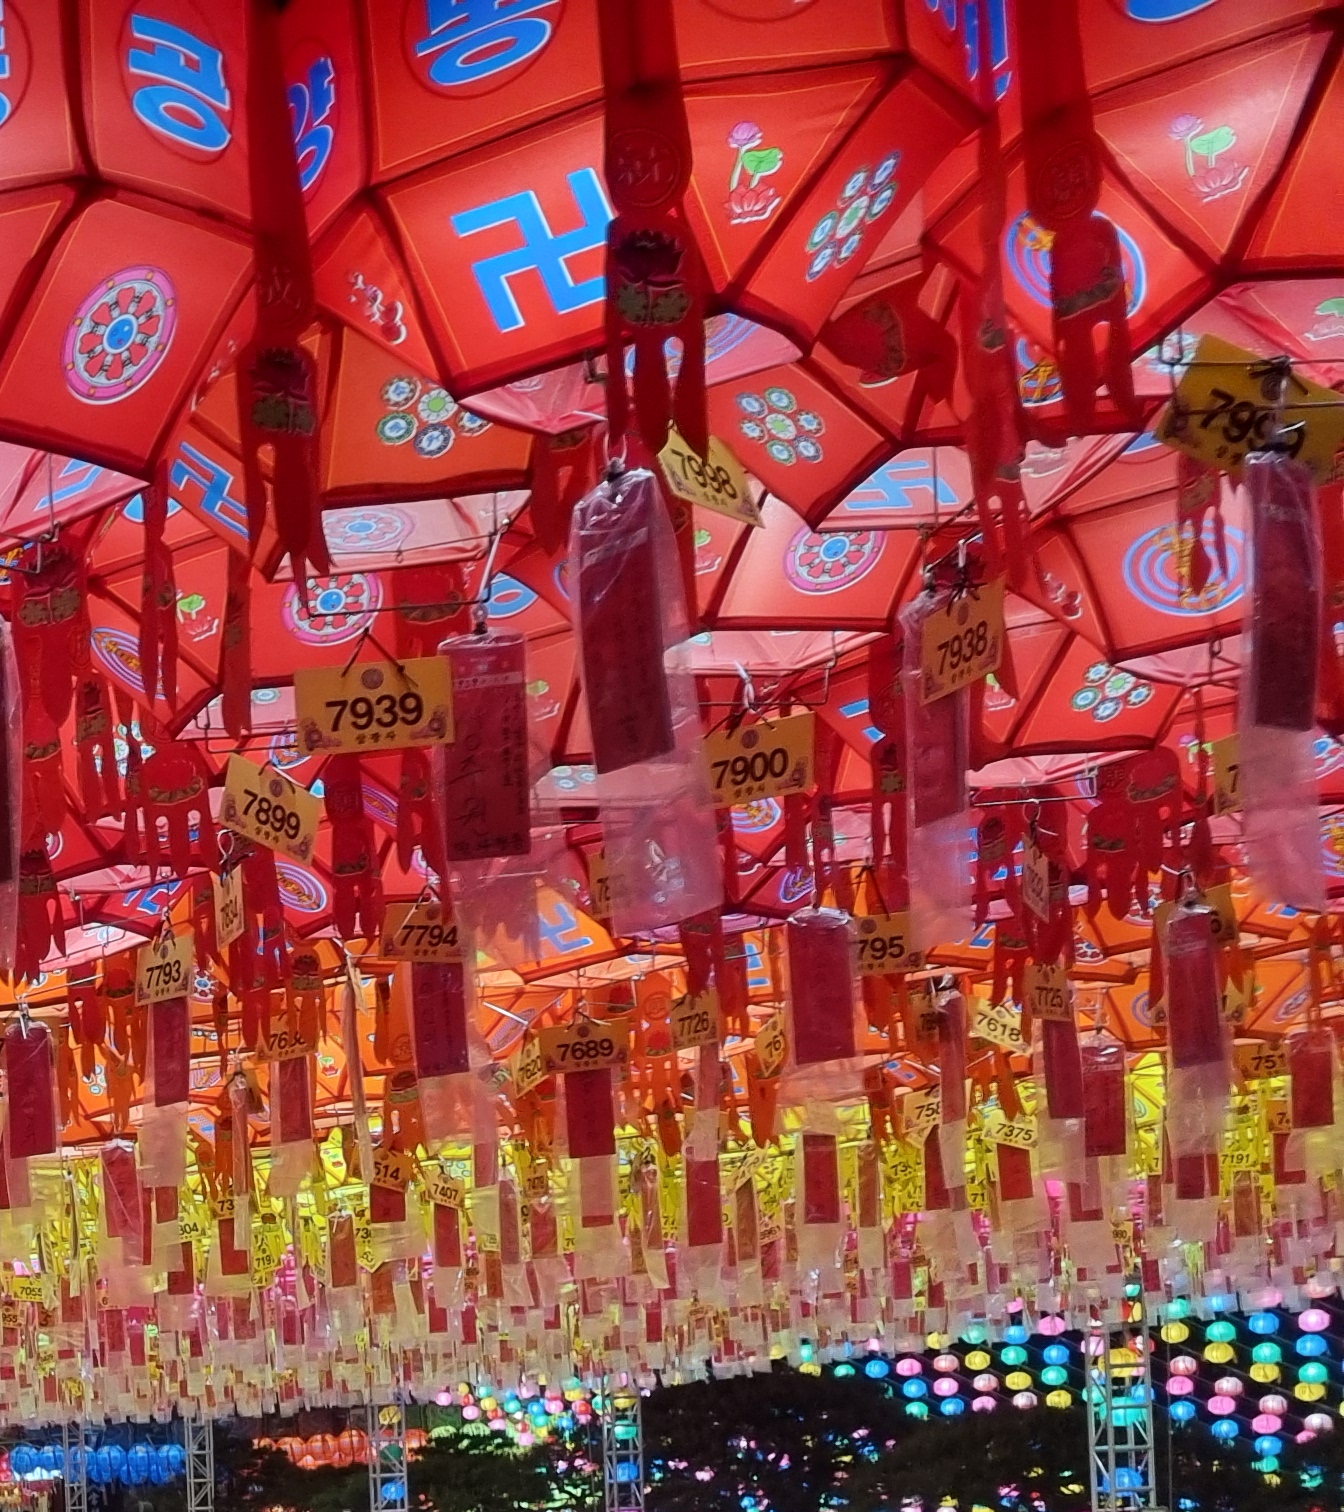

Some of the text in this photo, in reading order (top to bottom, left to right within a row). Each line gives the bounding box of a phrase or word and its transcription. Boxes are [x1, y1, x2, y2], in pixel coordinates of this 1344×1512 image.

[128, 12, 232, 152] 공
[937, 621, 989, 671] 7938
[325, 690, 424, 733] 7939
[712, 746, 789, 789] 7900
[242, 788, 301, 841] 7899
[401, 925, 459, 948] 7794
[147, 959, 181, 988] 7793
[1036, 986, 1065, 1009] 7725
[677, 1013, 710, 1036] 7726
[978, 1012, 1022, 1044] 7618
[558, 1037, 614, 1062] 7689
[997, 1123, 1033, 1141] 7375
[1221, 1154, 1250, 1164] 7191
[433, 1182, 459, 1202] 7407
